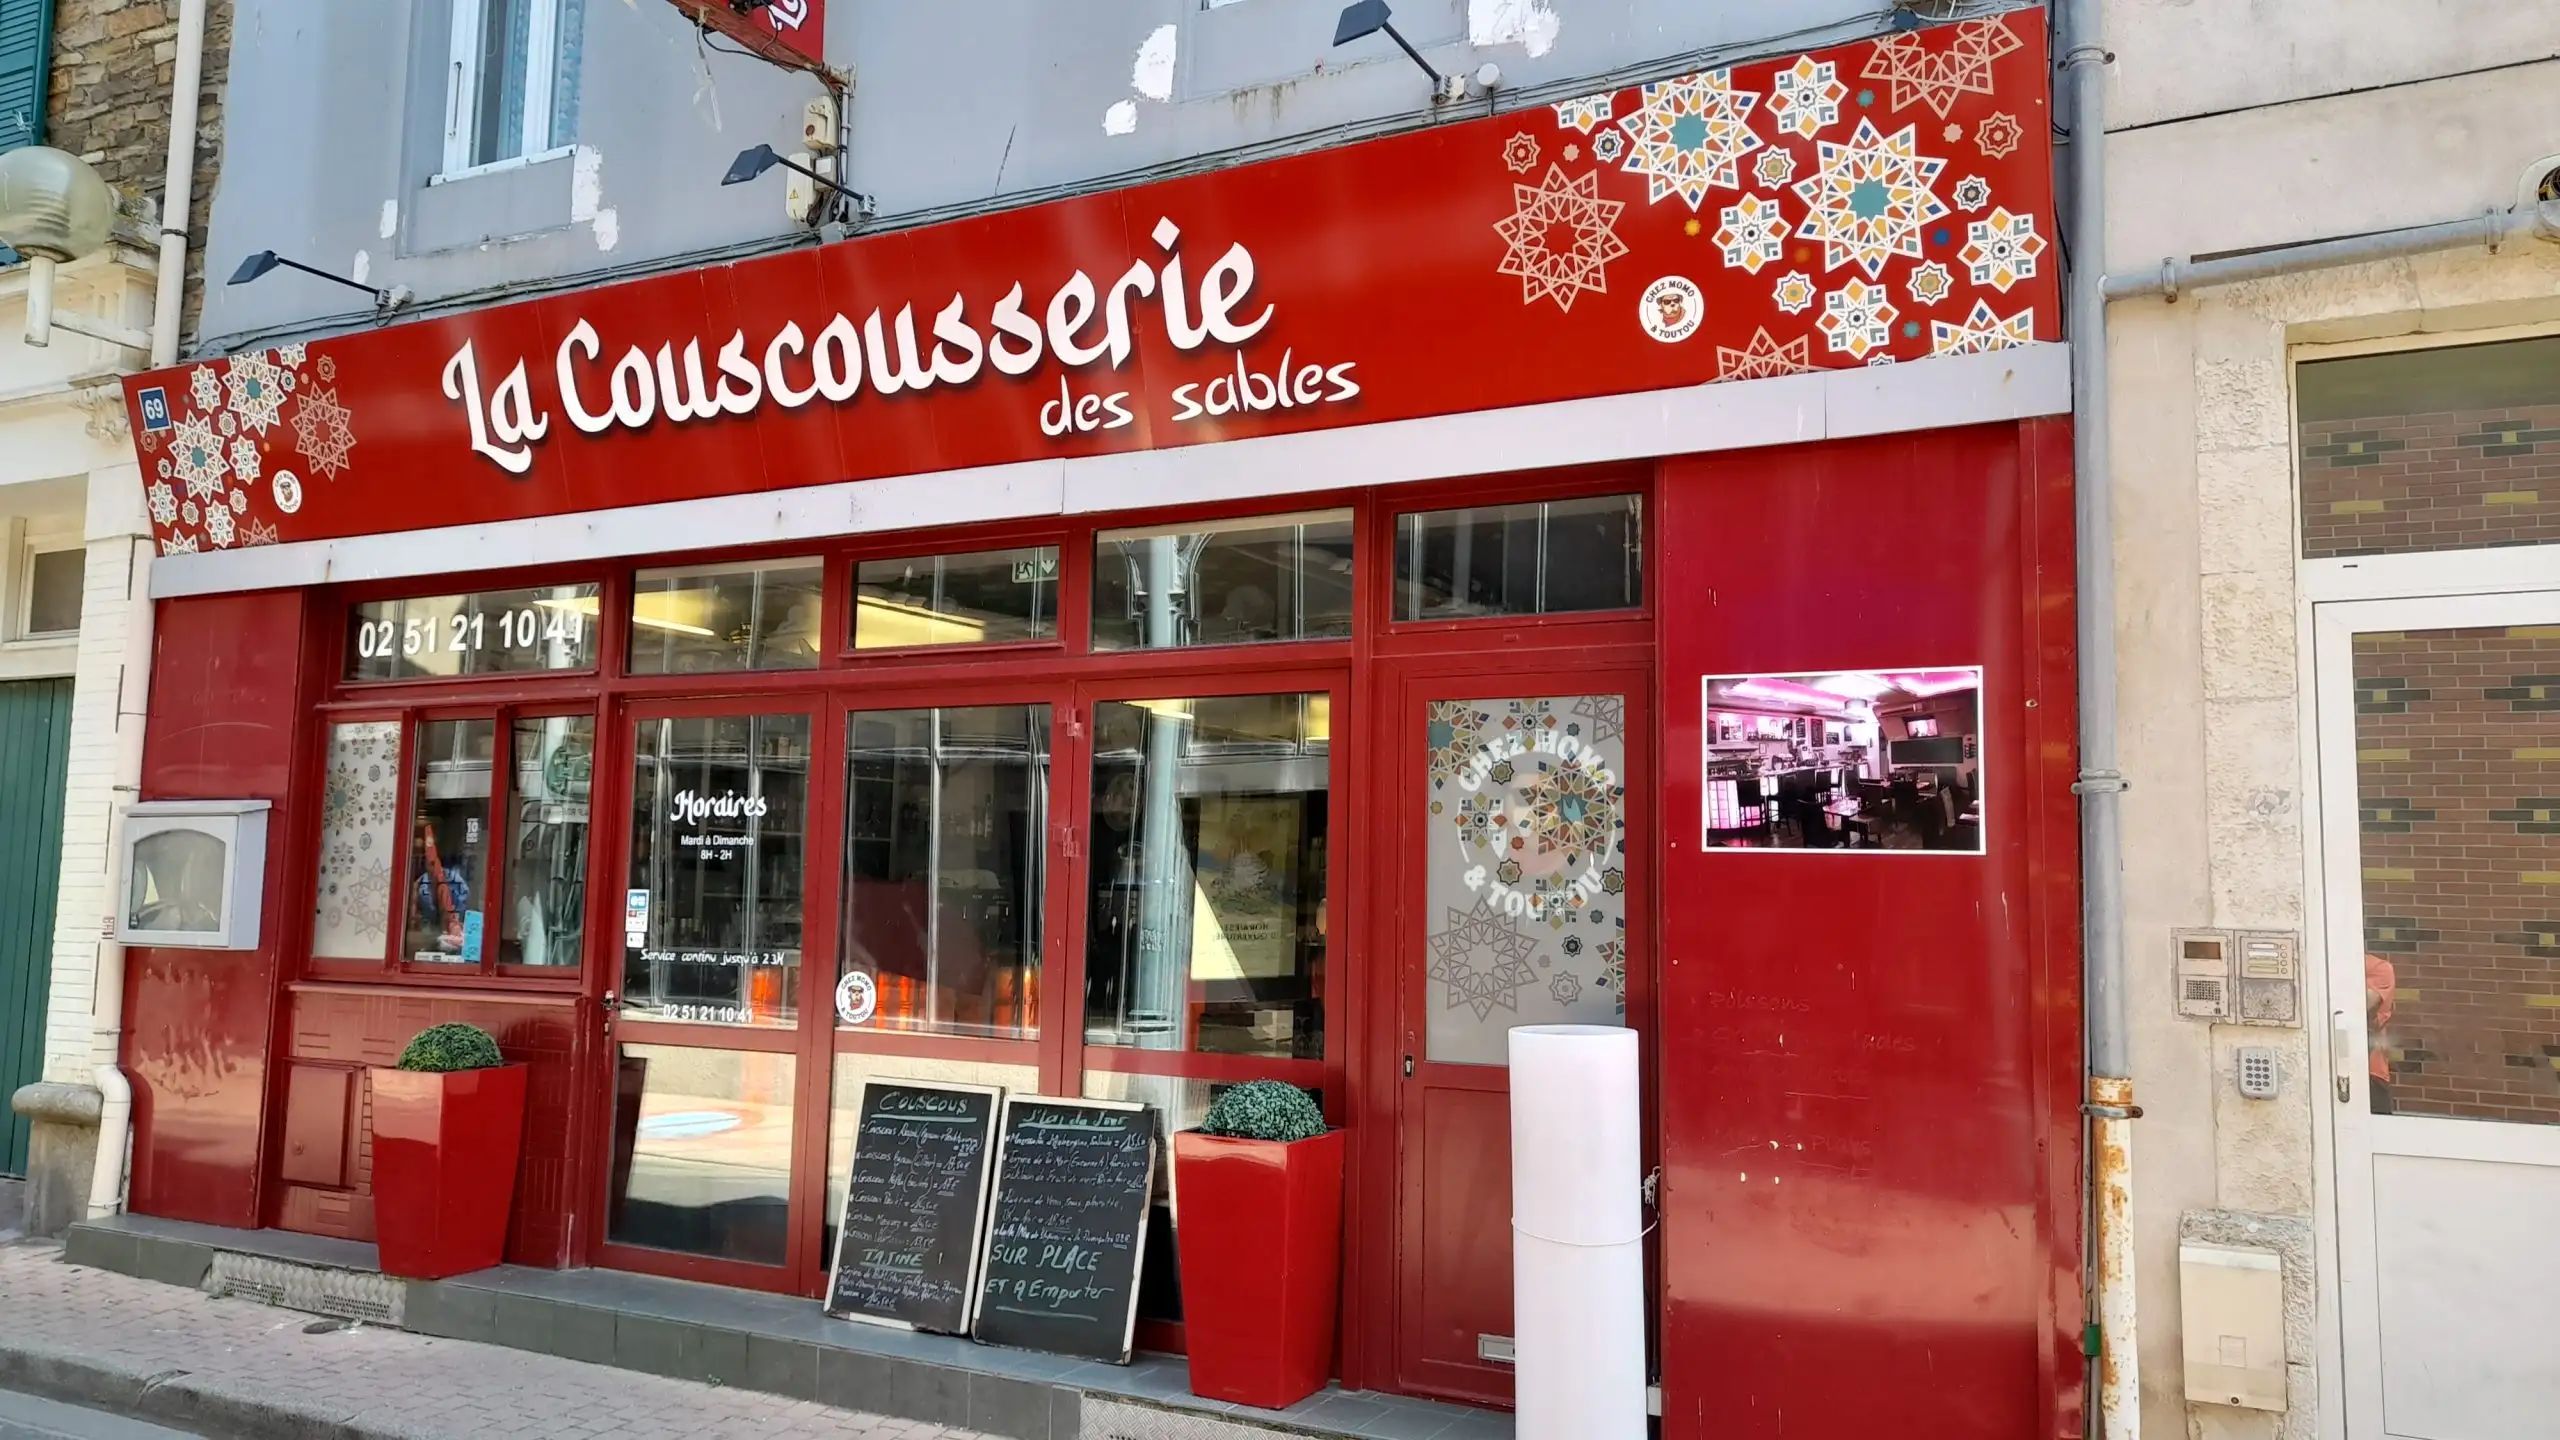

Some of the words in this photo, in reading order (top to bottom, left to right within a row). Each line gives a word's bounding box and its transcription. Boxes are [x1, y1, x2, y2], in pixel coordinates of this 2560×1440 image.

[1645, 282, 1667, 303] CHEZ
[1669, 280, 1694, 297] MOMO
[1659, 320, 1695, 339] TOUTOU
[442, 337, 547, 473] La
[556, 216, 1275, 432] Couscousserie
[1039, 375, 1133, 436] des
[1172, 349, 1361, 421] sables
[145, 398, 164, 420] 69
[358, 619, 393, 657] 02
[403, 616, 436, 654] 51
[449, 613, 483, 651] 21
[499, 610, 535, 648] 10
[547, 606, 583, 644] 41
[670, 789, 768, 826] Horaires
[681, 835, 703, 846] Mardi
[713, 835, 754, 846] Dimanche
[700, 850, 713, 860] 8H
[720, 850, 732, 860] 2H
[1463, 864, 1486, 891] &
[640, 949, 675, 961] Service
[681, 950, 716, 963] continu
[720, 950, 758, 966] jusqu'à
[841, 975, 855, 989] CHEZ
[857, 975, 872, 991] MOMO
[663, 1004, 679, 1020] 02
[681, 1004, 697, 1021] 51
[700, 1005, 716, 1021] 21
[719, 1005, 735, 1022] 10
[737, 1006, 753, 1023] 41
[990, 1244, 1029, 1265] SUR
[1036, 1245, 1103, 1275] PLACE
[985, 1279, 1010, 1294] ET
[1028, 1276, 1116, 1308] Emporter
